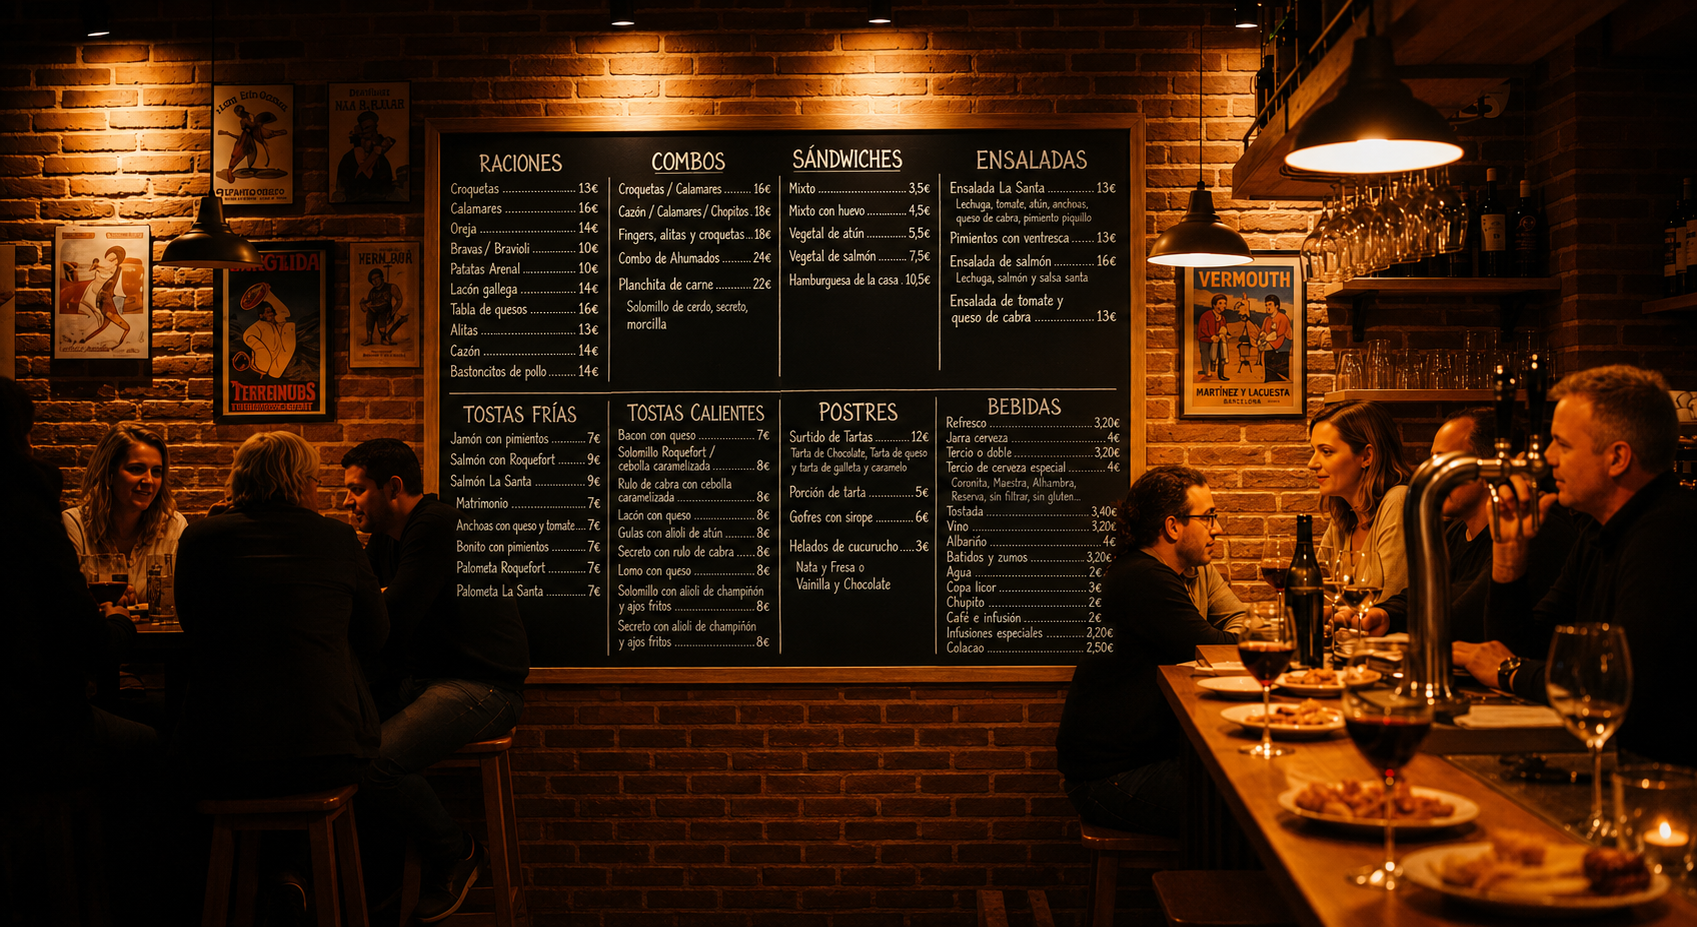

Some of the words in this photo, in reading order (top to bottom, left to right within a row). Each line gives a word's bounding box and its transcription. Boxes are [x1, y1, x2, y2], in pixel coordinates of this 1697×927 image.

[480, 154, 562, 172] RACIONES
[652, 152, 725, 170] COMBOS
[793, 145, 902, 168] SÁNDWICHES
[977, 150, 1087, 169] ENSALADAS
[451, 183, 499, 198] Croquetas
[579, 182, 598, 193] 13€
[619, 183, 664, 198] Croquetas
[676, 183, 722, 194] Calamares
[754, 183, 770, 194] 16€
[790, 182, 816, 194] Mixto
[909, 182, 930, 195] 3,5€
[950, 182, 994, 194] Ensalada
[1000, 182, 1012, 193] La
[1016, 181, 1044, 193] Santa
[1098, 182, 1116, 193] 13€
[451, 202, 502, 214] Calamares
[579, 202, 598, 213] 16€
[789, 205, 815, 216] Mixto
[819, 208, 835, 216] con
[838, 204, 865, 216] huevo
[909, 204, 930, 217] 4,5€
[619, 228, 656, 244] Fingers,
[660, 228, 686, 240] alitas
[690, 232, 696, 244] y
[699, 228, 744, 244] croquetas
[755, 228, 771, 239] 18€
[950, 231, 998, 244] Pimientos
[1002, 235, 1020, 243] con
[1024, 232, 1069, 243] ventresca
[1098, 232, 1116, 243] 13€
[619, 252, 651, 264] Combo
[655, 251, 666, 264] de
[670, 251, 720, 263] Ahumados
[753, 252, 771, 262] 24€
[789, 250, 824, 266] Vegetal
[828, 250, 840, 261] de
[843, 250, 876, 261] salmón
[910, 250, 930, 263] 7,5€
[451, 263, 484, 274] Patatas
[489, 262, 520, 274] Arenal
[579, 262, 598, 274] 10€
[790, 273, 850, 290] Hamburguesa
[854, 273, 864, 285] de
[868, 273, 875, 285] la
[878, 277, 898, 285] casa
[906, 273, 930, 286] 10,5€
[1198, 271, 1291, 288] VERMOUTH
[451, 283, 479, 295] Lacón
[483, 282, 517, 298] gallega
[579, 282, 598, 294] 14€
[627, 300, 669, 312] Solomillo
[672, 300, 684, 312] de
[687, 300, 713, 313] cerdo,
[716, 301, 748, 313] secreto,
[950, 294, 996, 306] Ensalada
[1001, 294, 1013, 306] de
[1018, 294, 1053, 306] tomate
[1057, 298, 1063, 310] y
[450, 303, 475, 315] Tabla
[480, 303, 491, 314] de
[495, 306, 527, 319] quesos
[579, 302, 598, 314] 16€
[627, 317, 666, 330] morcilla
[952, 315, 981, 328] queso
[986, 310, 998, 322] de
[1003, 310, 1031, 322] cabra
[1098, 310, 1116, 322] 13€
[451, 365, 506, 377] Bastoncitos
[510, 365, 521, 377] de
[525, 365, 546, 381] pollo
[579, 365, 598, 376] 14€
[1196, 385, 1239, 397] MARTÍNEZ
[1240, 388, 1247, 397] Y
[1249, 388, 1291, 397] LACUESTA
[463, 406, 524, 423] TOSTAS
[533, 402, 576, 422] FRÍAS
[627, 404, 683, 421] TOSTAS
[691, 403, 764, 421] CALIENTES
[819, 402, 898, 421] POSTRES
[988, 398, 1061, 415] BEBIDAS
[450, 432, 482, 444] Jamón
[486, 436, 502, 444] con
[506, 432, 548, 448] pimientos
[588, 432, 600, 443] 7€
[618, 429, 646, 440] Bacon
[670, 432, 696, 444] queso
[757, 429, 770, 440] 7€
[790, 430, 825, 442] Surtido
[829, 430, 840, 442] de
[844, 430, 873, 442] Tartas
[912, 431, 929, 442] 12€
[946, 432, 970, 443] Jarra
[1108, 432, 1120, 442] 4€
[618, 478, 638, 489] Rulo
[641, 478, 651, 489] de
[655, 478, 679, 489] cabra
[701, 478, 732, 489] cebolla
[618, 491, 674, 502] caramelizada
[757, 491, 770, 502] 8€
[790, 485, 824, 498] Porción
[828, 486, 840, 498] de
[844, 486, 866, 497] tarta
[916, 486, 928, 497] 5€
[456, 497, 508, 508] Matrimonio
[588, 497, 600, 508] 7€
[946, 506, 983, 516] Tostada
[456, 519, 493, 531] Anchoas
[512, 523, 536, 534] queso
[539, 524, 544, 534] y
[546, 520, 575, 531] tomate
[588, 519, 600, 530] 7€
[790, 540, 828, 552] Helados
[832, 540, 844, 552] de
[848, 540, 898, 552] cucurucho
[916, 540, 929, 552] 3€
[457, 561, 497, 573] Palometa
[501, 561, 545, 577] Roquefort
[588, 562, 600, 573] 7€
[618, 564, 643, 576] Lomo
[646, 568, 662, 576] con
[666, 568, 691, 580] queso
[757, 564, 770, 576] 8€
[796, 577, 830, 590] Vainilla
[834, 582, 840, 594] y
[844, 577, 890, 590] Chocolate
[947, 581, 971, 596] Copa
[976, 581, 996, 592] licor
[1089, 582, 1101, 593] 3€
[947, 611, 969, 623] Café
[974, 615, 979, 623] e
[984, 611, 1021, 622] infusión
[1089, 612, 1101, 622] 2€
[947, 641, 984, 653] Colacao
[1087, 642, 1113, 654] 2,50€
